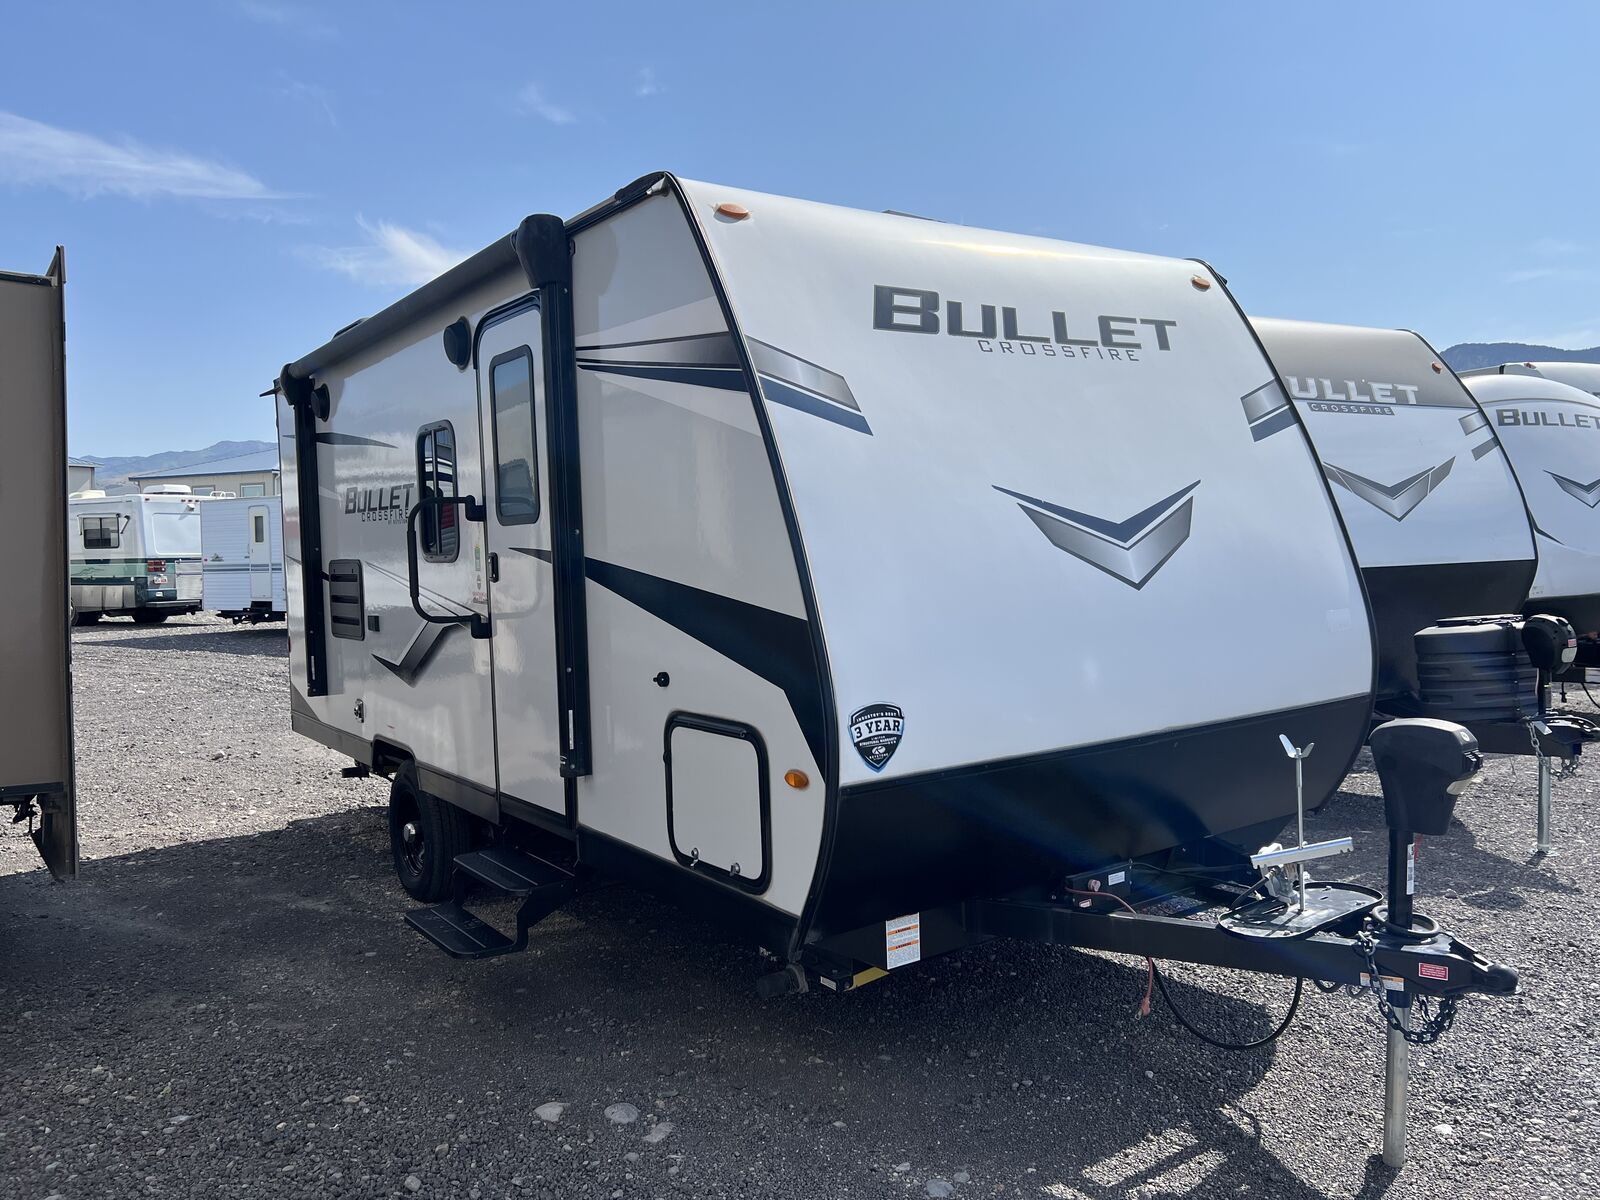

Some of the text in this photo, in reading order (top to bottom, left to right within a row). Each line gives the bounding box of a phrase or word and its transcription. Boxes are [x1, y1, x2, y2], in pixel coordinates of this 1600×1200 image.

[873, 284, 1177, 351] BULLET
[977, 339, 1140, 362] CROSSFIRE
[1285, 375, 1419, 405] ULLET
[1310, 403, 1392, 415] CROSSFIRE
[345, 482, 415, 515] BULLET
[362, 508, 409, 522] CROSSFIRE
[854, 719, 901, 739] 3 YEAR
